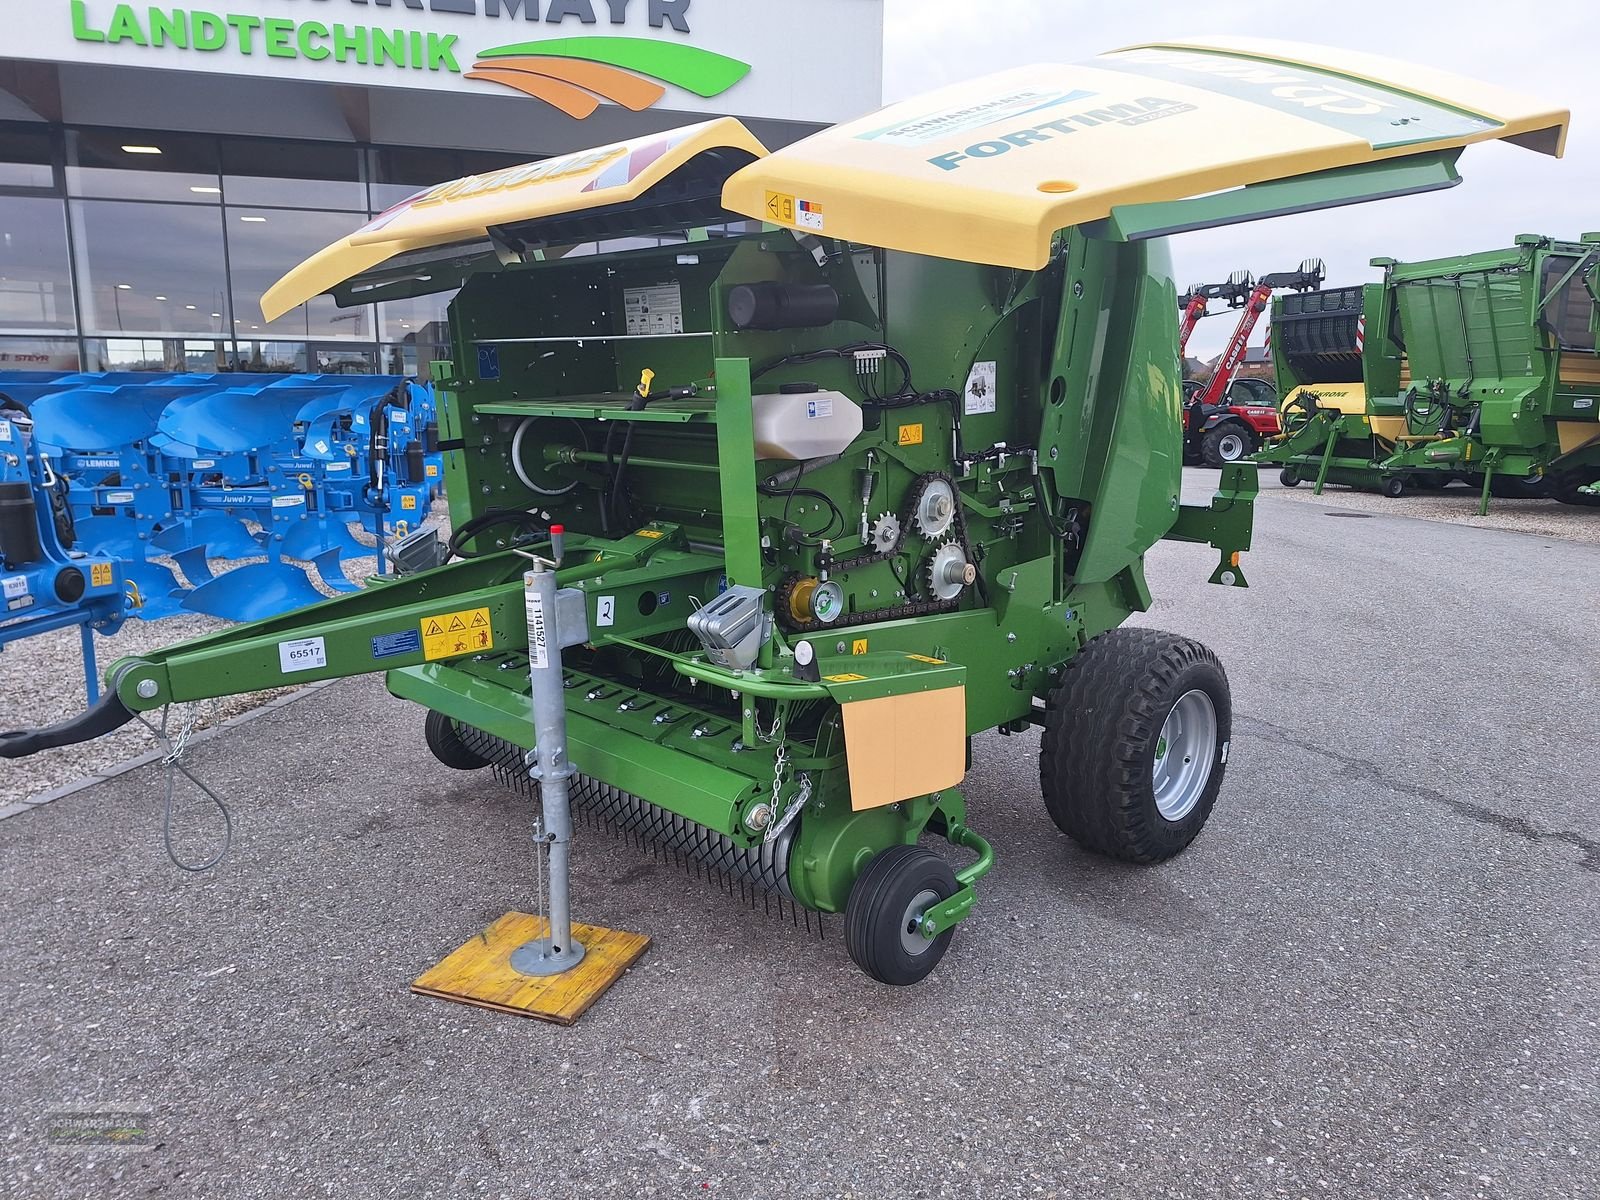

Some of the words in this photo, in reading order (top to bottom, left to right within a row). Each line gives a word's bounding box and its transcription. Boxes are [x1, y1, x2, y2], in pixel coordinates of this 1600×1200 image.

[71, 0, 461, 73] LANDTECHNIK
[926, 96, 1183, 171] FORTIMA
[15, 354, 49, 362] STEYR
[86, 459, 120, 468] LEMKEN
[222, 495, 246, 503] Juwel
[247, 495, 253, 503] 7
[602, 601, 612, 620] 2
[533, 608, 546, 648] 1141527
[289, 647, 321, 660] 65517
